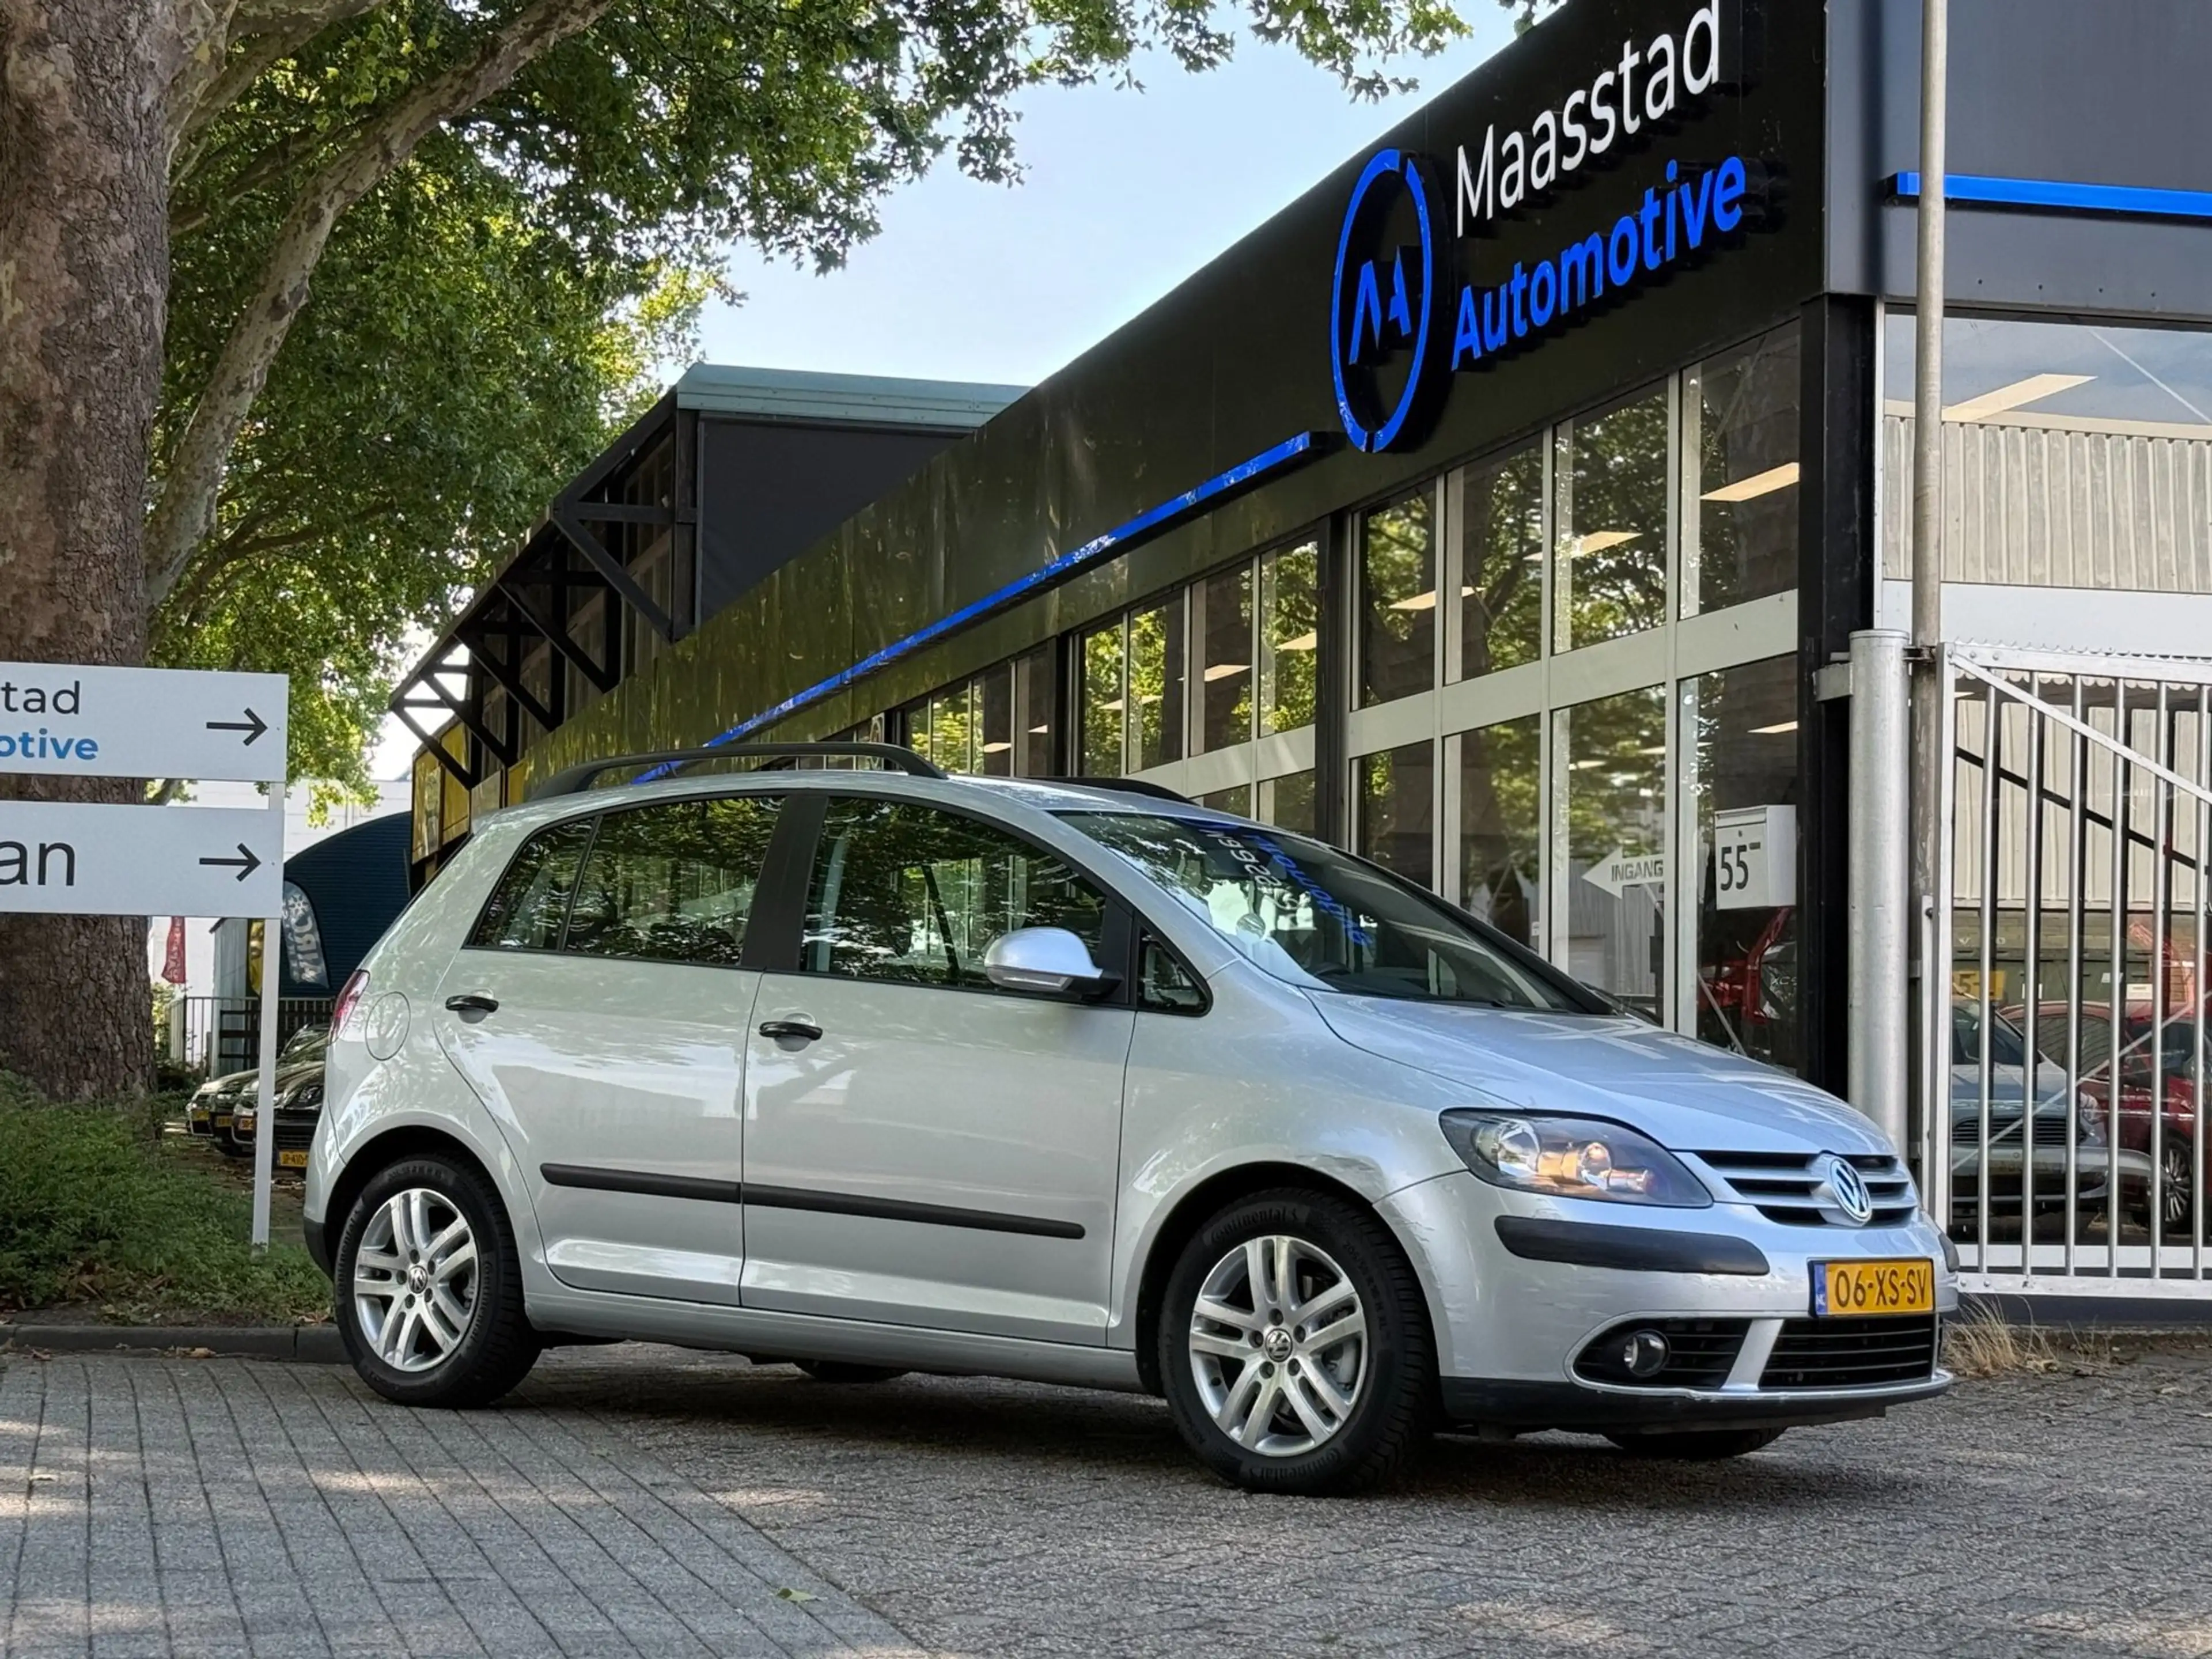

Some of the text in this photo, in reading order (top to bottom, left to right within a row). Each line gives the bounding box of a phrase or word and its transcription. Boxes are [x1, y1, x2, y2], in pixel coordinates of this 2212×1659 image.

[1456, 0, 1719, 238] Maasstad
[1452, 154, 1746, 372] Automotive
[1, 680, 80, 715] tad
[1611, 859, 1664, 882] INGANG
[1835, 1268, 1927, 1308] 06-XS-SV
